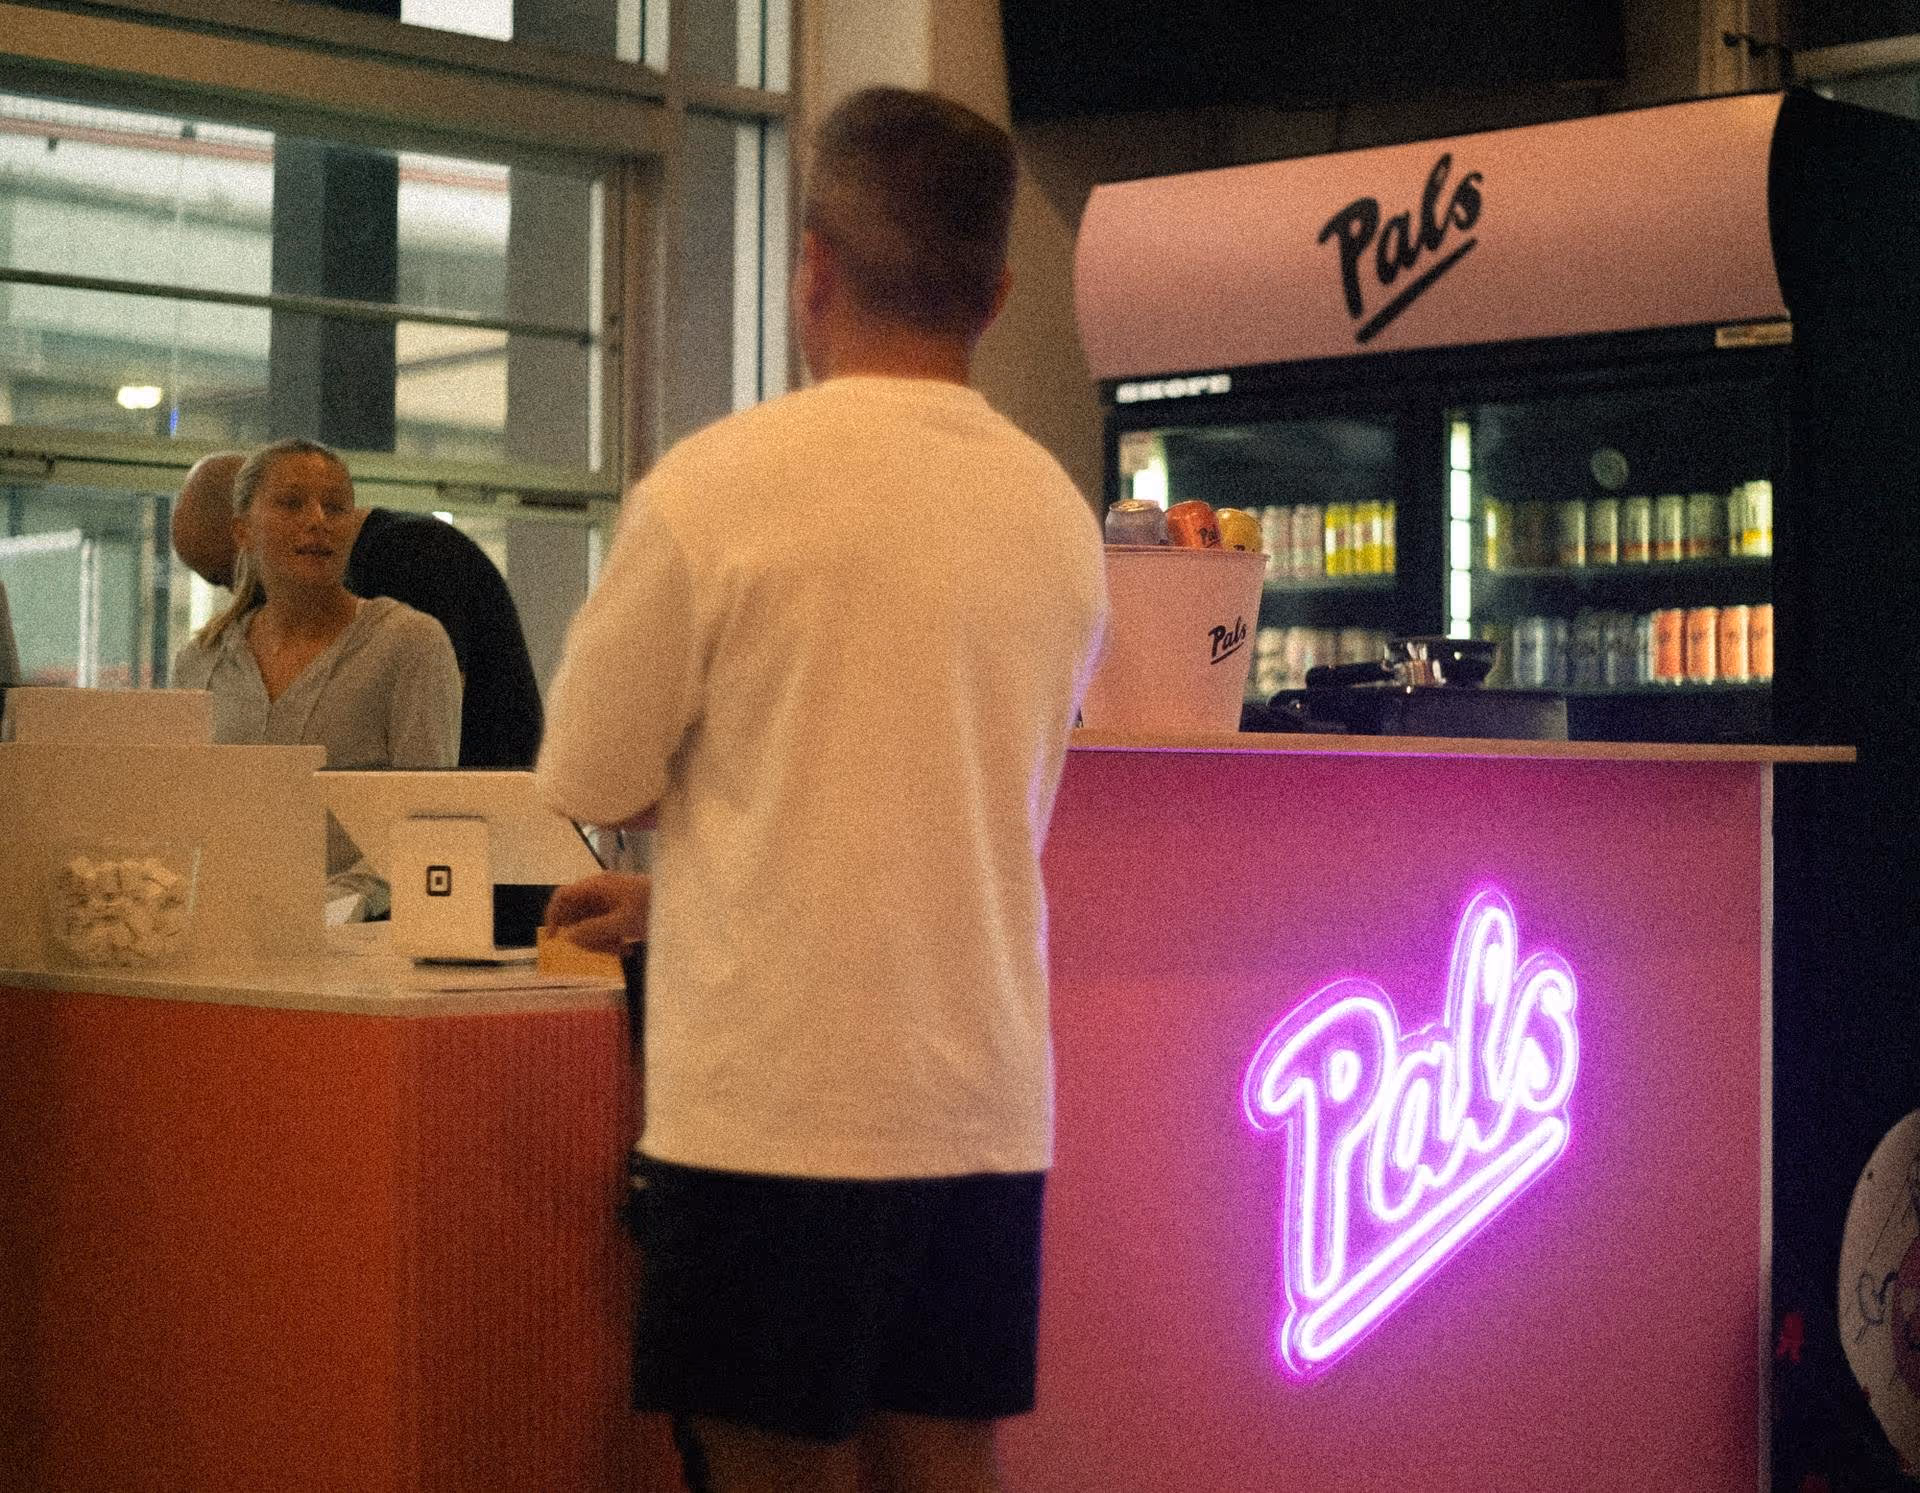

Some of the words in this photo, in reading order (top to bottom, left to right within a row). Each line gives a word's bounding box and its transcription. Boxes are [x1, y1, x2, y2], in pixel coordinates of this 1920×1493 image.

[1318, 153, 1484, 321] Pals
[1208, 615, 1247, 658] Pals
[1259, 903, 1576, 1300] Pals
